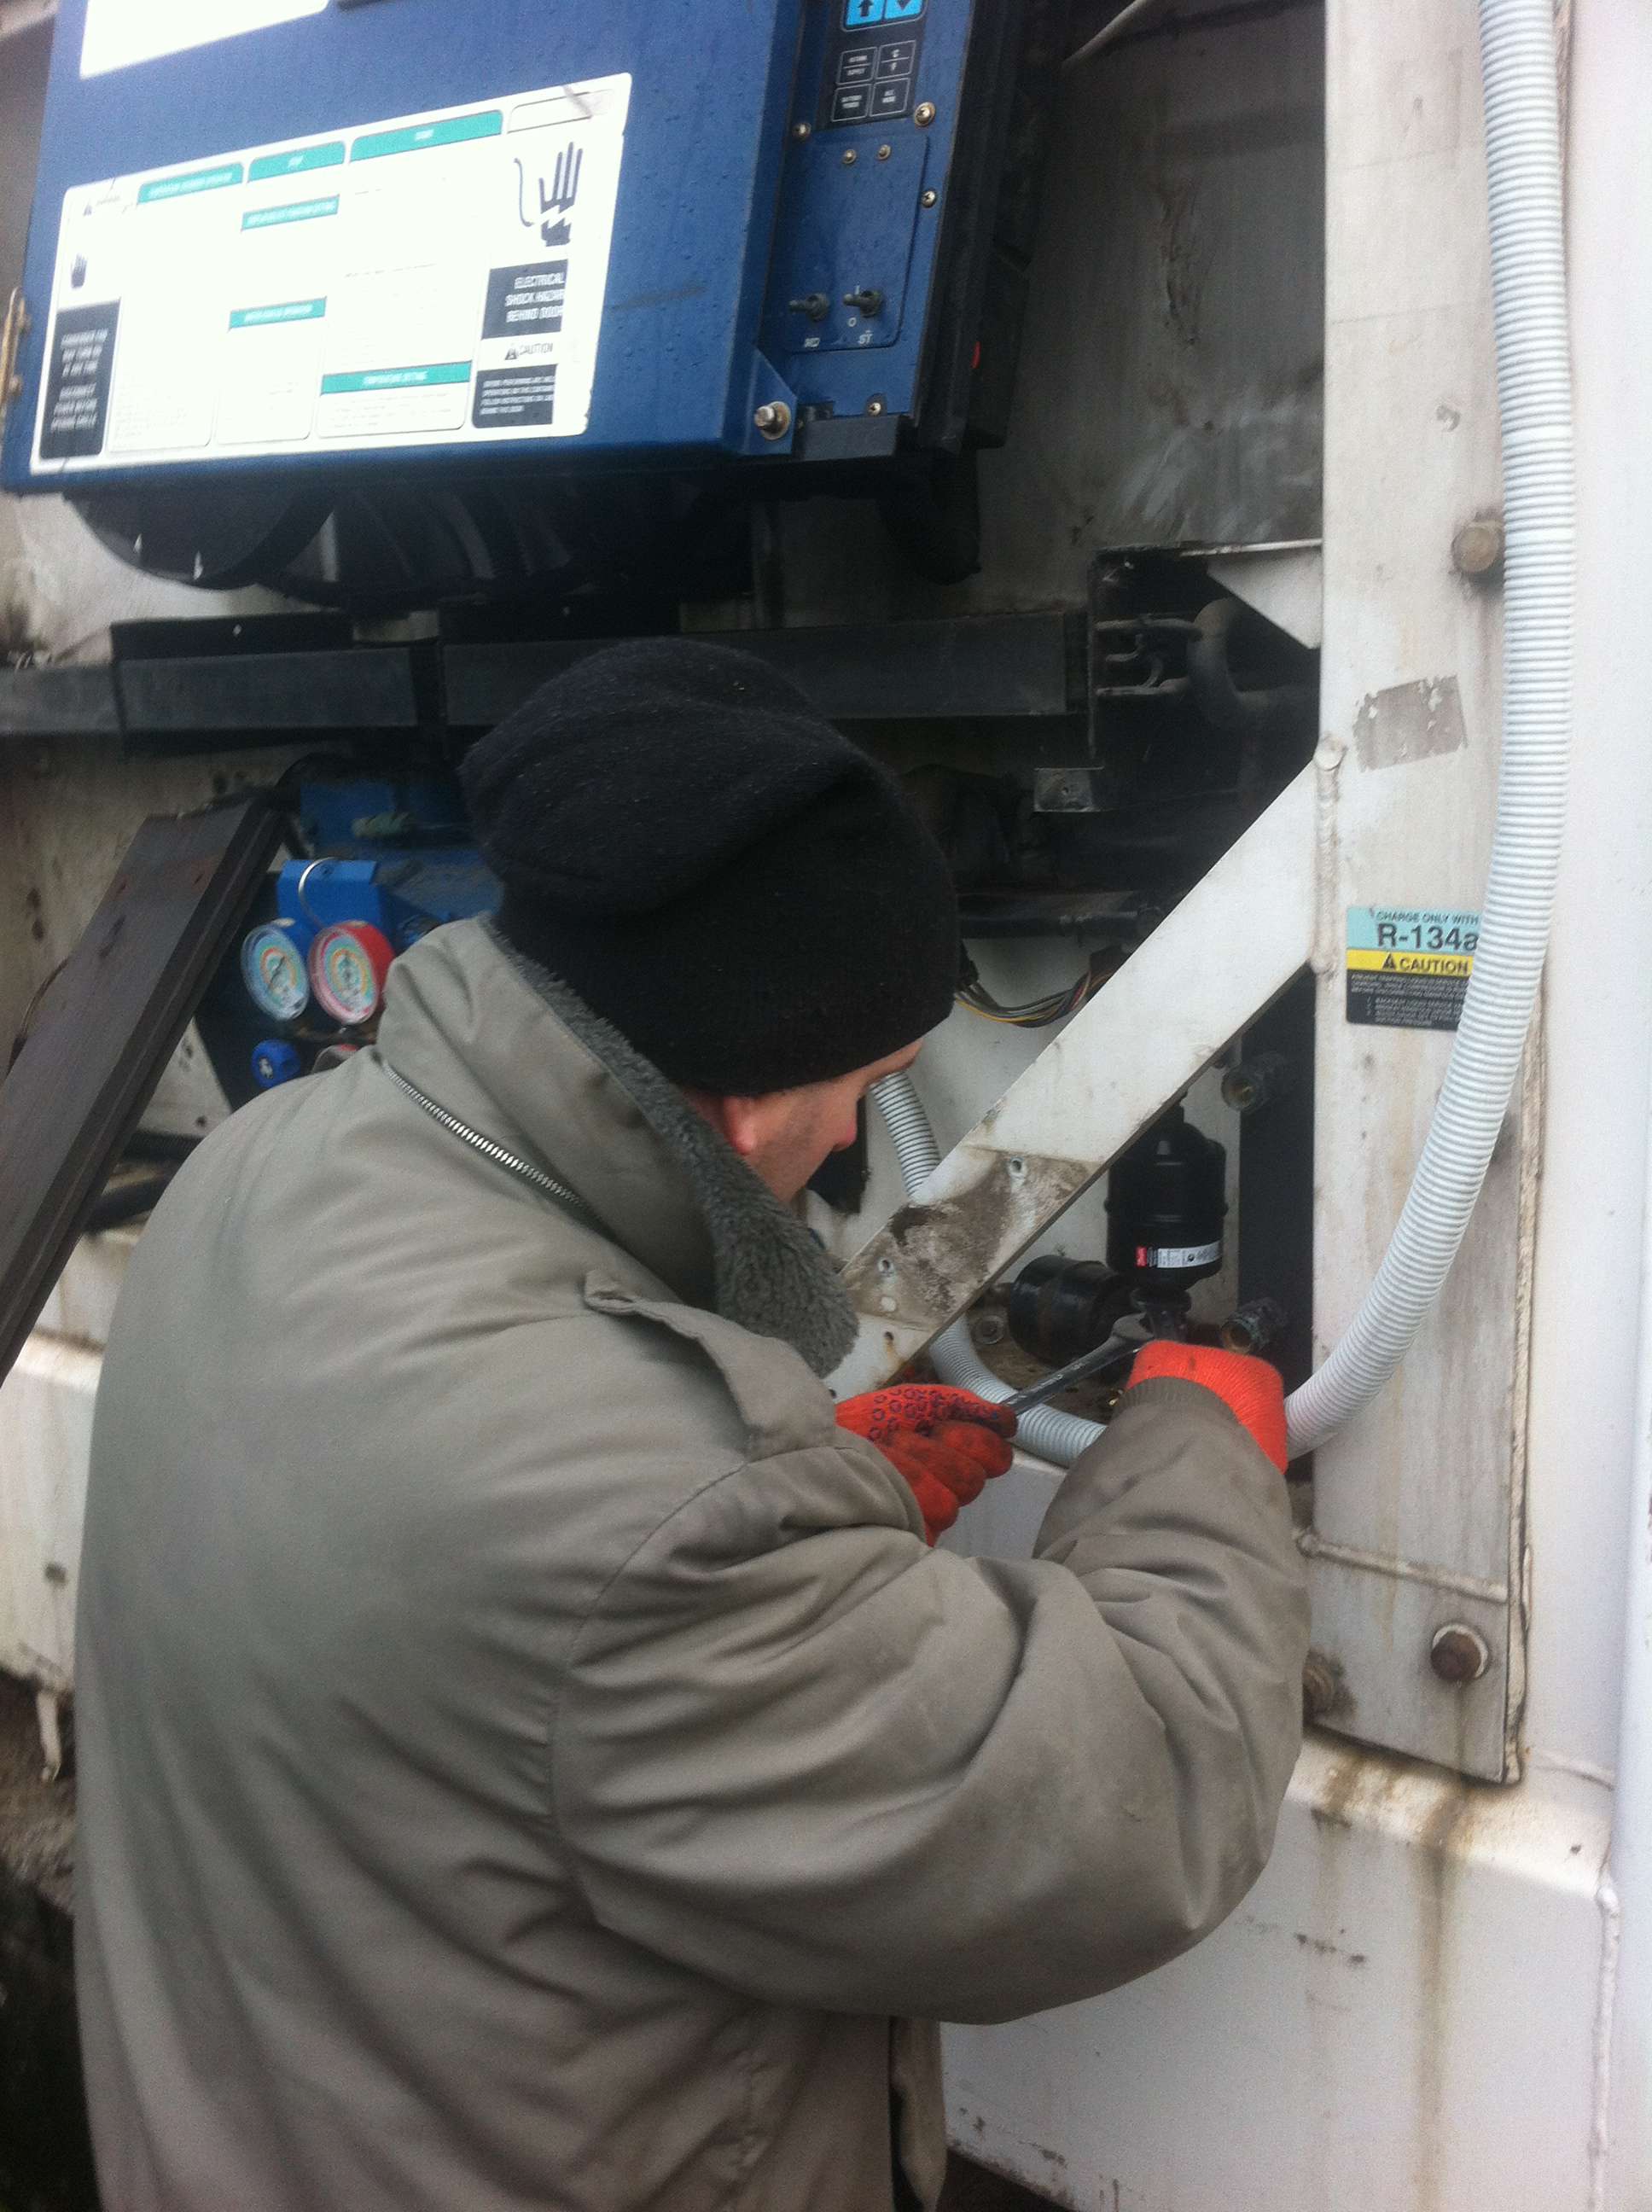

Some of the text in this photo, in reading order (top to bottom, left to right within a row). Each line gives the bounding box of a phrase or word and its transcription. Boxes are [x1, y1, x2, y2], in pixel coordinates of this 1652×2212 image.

[1376, 911, 1480, 925] CHARGE ONLY WITH
[1377, 923, 1480, 952] R-134a
[1399, 957, 1469, 975] CAUTION
